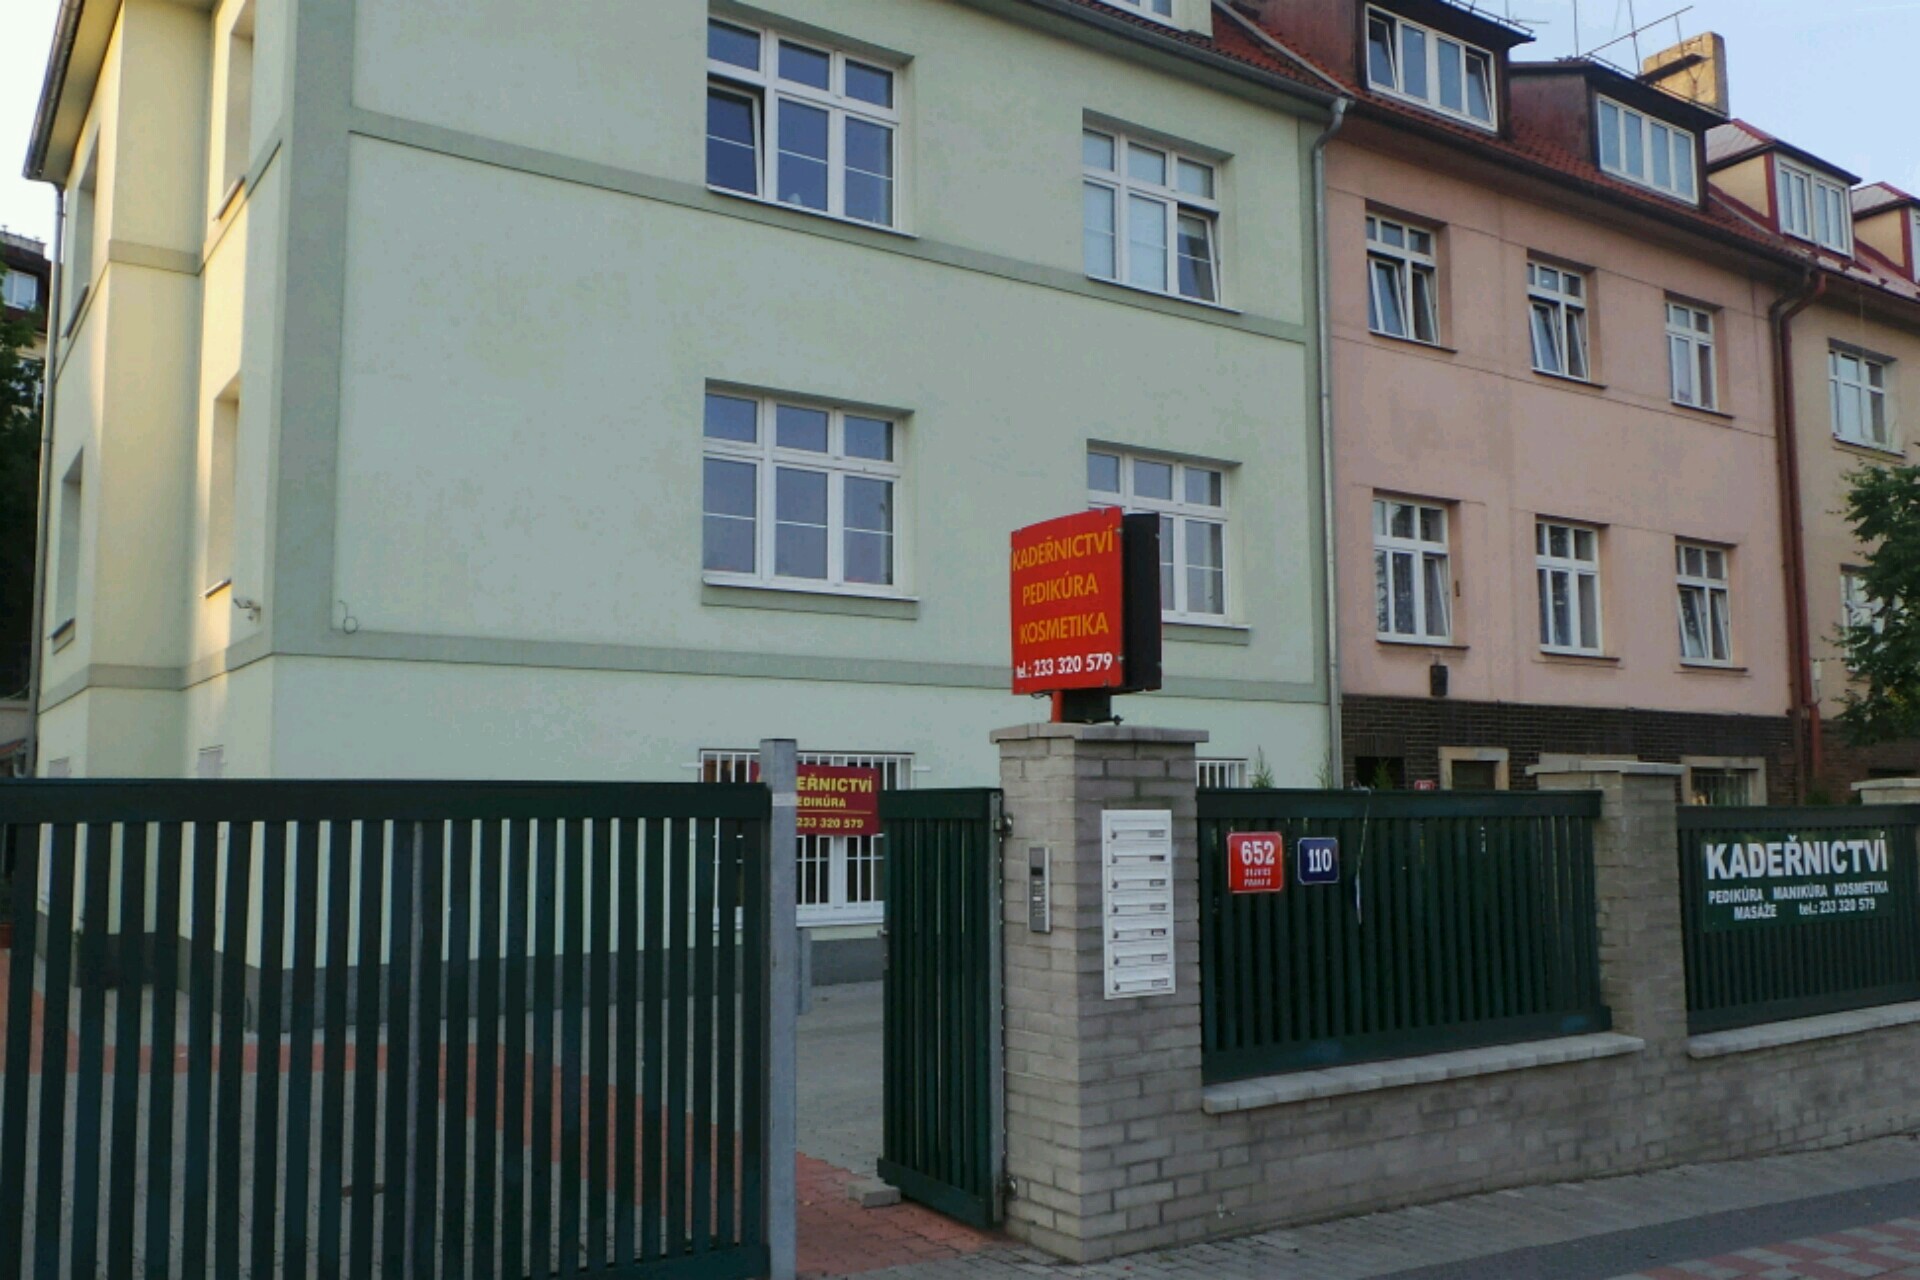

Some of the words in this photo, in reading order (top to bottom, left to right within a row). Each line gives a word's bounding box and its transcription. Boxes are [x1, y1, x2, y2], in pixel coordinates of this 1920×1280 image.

[1012, 524, 1114, 571] KADEŘNICTVÍ
[1022, 571, 1098, 606] PEDIKÚRA
[1020, 612, 1109, 645] KOSMETIKA
[1034, 658, 1054, 677] 233
[1058, 655, 1081, 675] 320
[1086, 652, 1113, 672] 579
[797, 773, 872, 793] EŘNICTVÍ
[797, 794, 846, 809] EDIKÚRA
[820, 817, 840, 829] 320
[1241, 840, 1275, 866] 652
[1308, 848, 1332, 873] 110
[1705, 831, 1888, 880] KADEŘNICTVÍ
[1708, 885, 1764, 904] PEDIKÚRA
[1773, 882, 1828, 900] MANIKÚRA
[1834, 880, 1889, 896] KOSMETIKA
[1733, 903, 1777, 921] MASÁŽE
[1819, 899, 1836, 914] 233
[1838, 898, 1856, 912] 320
[1858, 898, 1876, 911] 579
